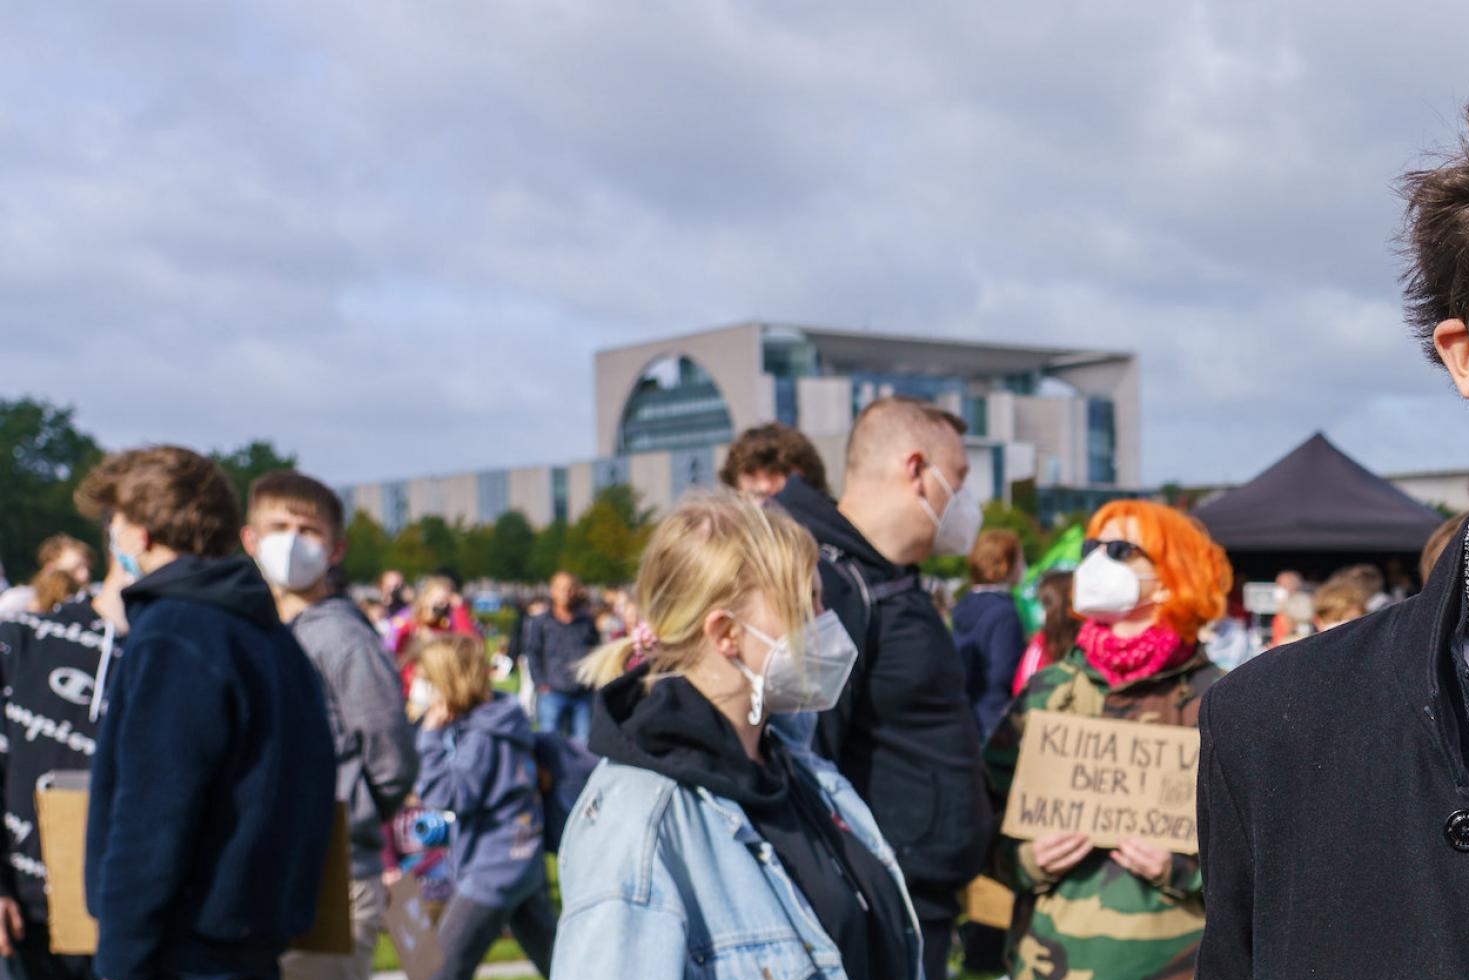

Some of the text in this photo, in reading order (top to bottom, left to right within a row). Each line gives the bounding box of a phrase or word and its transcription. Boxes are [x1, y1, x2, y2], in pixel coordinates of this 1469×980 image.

[1040, 724, 1118, 762] KLIMA
[1130, 737, 1167, 768] IST
[1020, 793, 1085, 830] WARM
